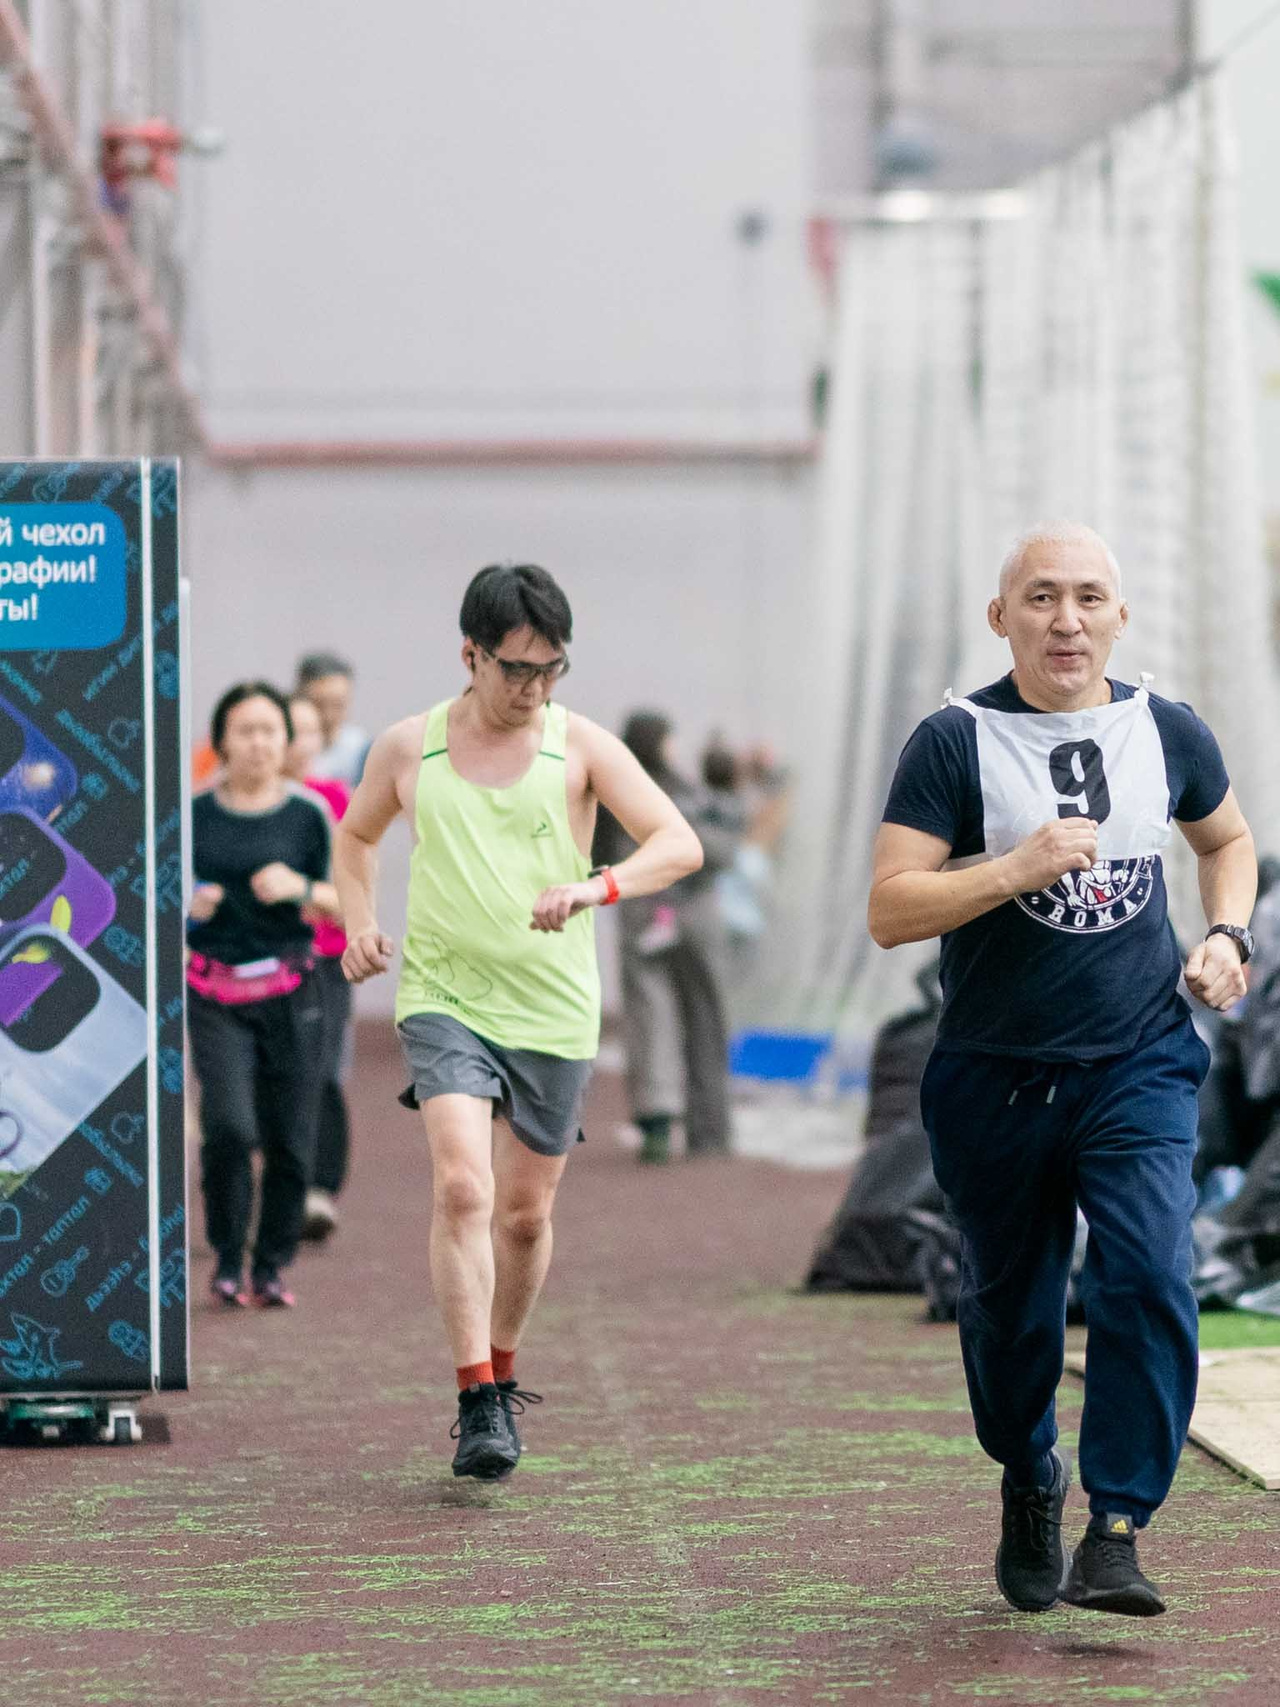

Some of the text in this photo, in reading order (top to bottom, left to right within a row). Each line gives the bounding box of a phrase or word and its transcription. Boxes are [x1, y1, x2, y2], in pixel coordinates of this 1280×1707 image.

[22, 523, 105, 546] чехол
[0, 554, 97, 589] рафии!
[1049, 738, 1111, 825] 9
[1048, 898, 1138, 927] ROMA
